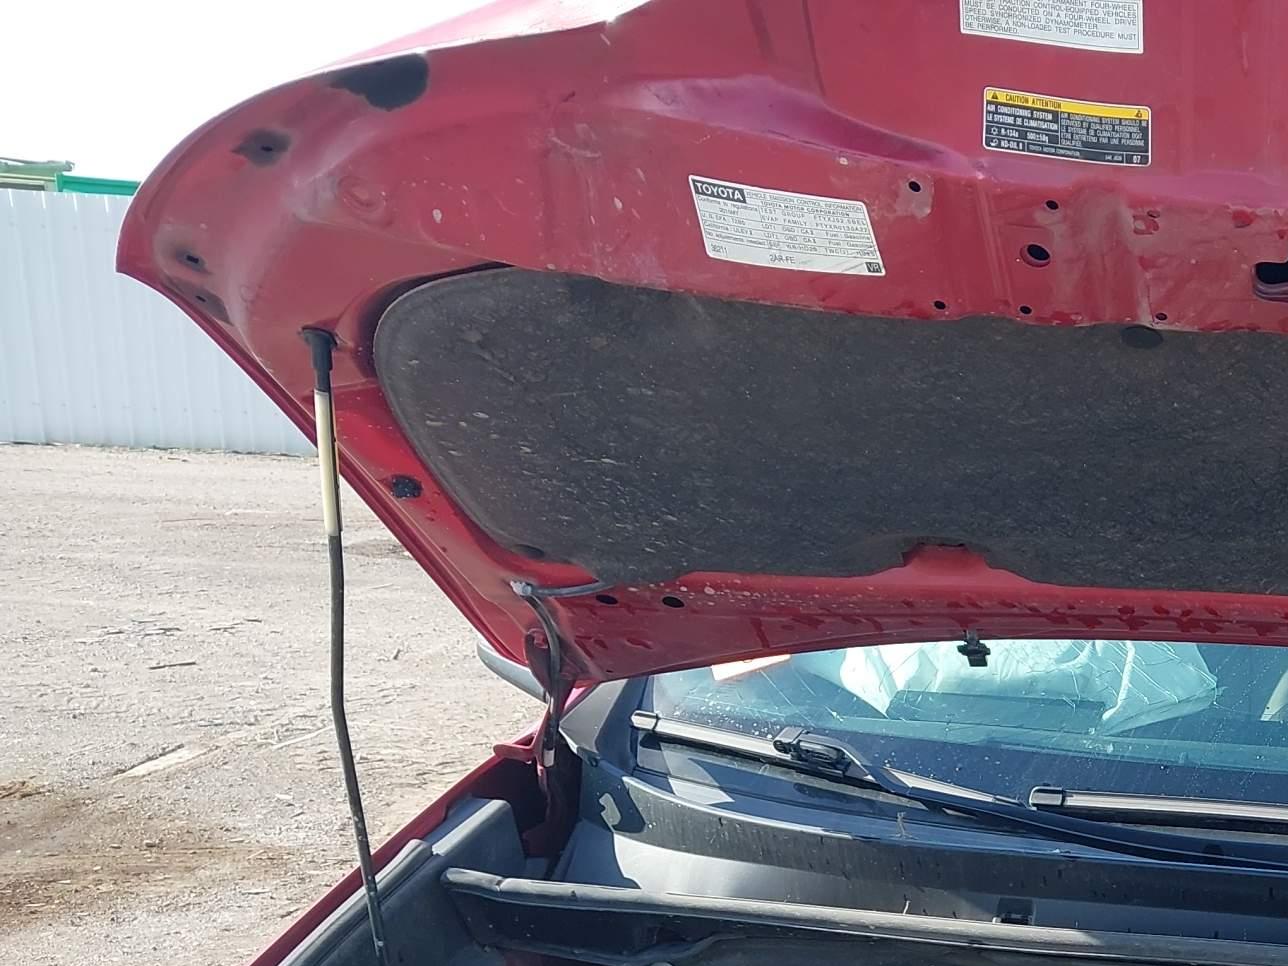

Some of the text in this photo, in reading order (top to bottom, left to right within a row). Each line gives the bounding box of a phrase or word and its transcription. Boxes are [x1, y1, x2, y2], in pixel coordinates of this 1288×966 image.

[965, 6, 986, 15] SPEED
[990, 10, 1041, 23] SYNCHRONIZED
[1091, 2, 1136, 11] FOUR-WHEEL
[1103, 10, 1136, 18] VEHICLES
[999, 5, 1039, 15] CONDUCTED
[1065, 13, 1110, 24] FOUR-WHEEL
[1114, 18, 1136, 26] DRIVE
[1013, 21, 1052, 31] NON-LOADED
[1056, 26, 1071, 34] TEST
[1074, 28, 1114, 39] PROCEDURE
[1118, 32, 1136, 40] MUST
[1005, 93, 1062, 109] CAUTION ATTENTION
[987, 104, 1053, 120] AIR CONDITIONING SYSTEM
[987, 113, 993, 121] LE
[1016, 117, 1023, 125] DE
[1024, 118, 1058, 130] CLIMATISATION
[694, 182, 744, 201] TOYOTA
[760, 200, 781, 208] TOYOTA
[806, 207, 850, 217] CORPORATION
[761, 207, 776, 215] TEST
[782, 210, 805, 219] GROUP
[783, 218, 807, 227] FAMILY
[769, 253, 796, 264] 2AR-FE
[867, 262, 880, 272] VR
